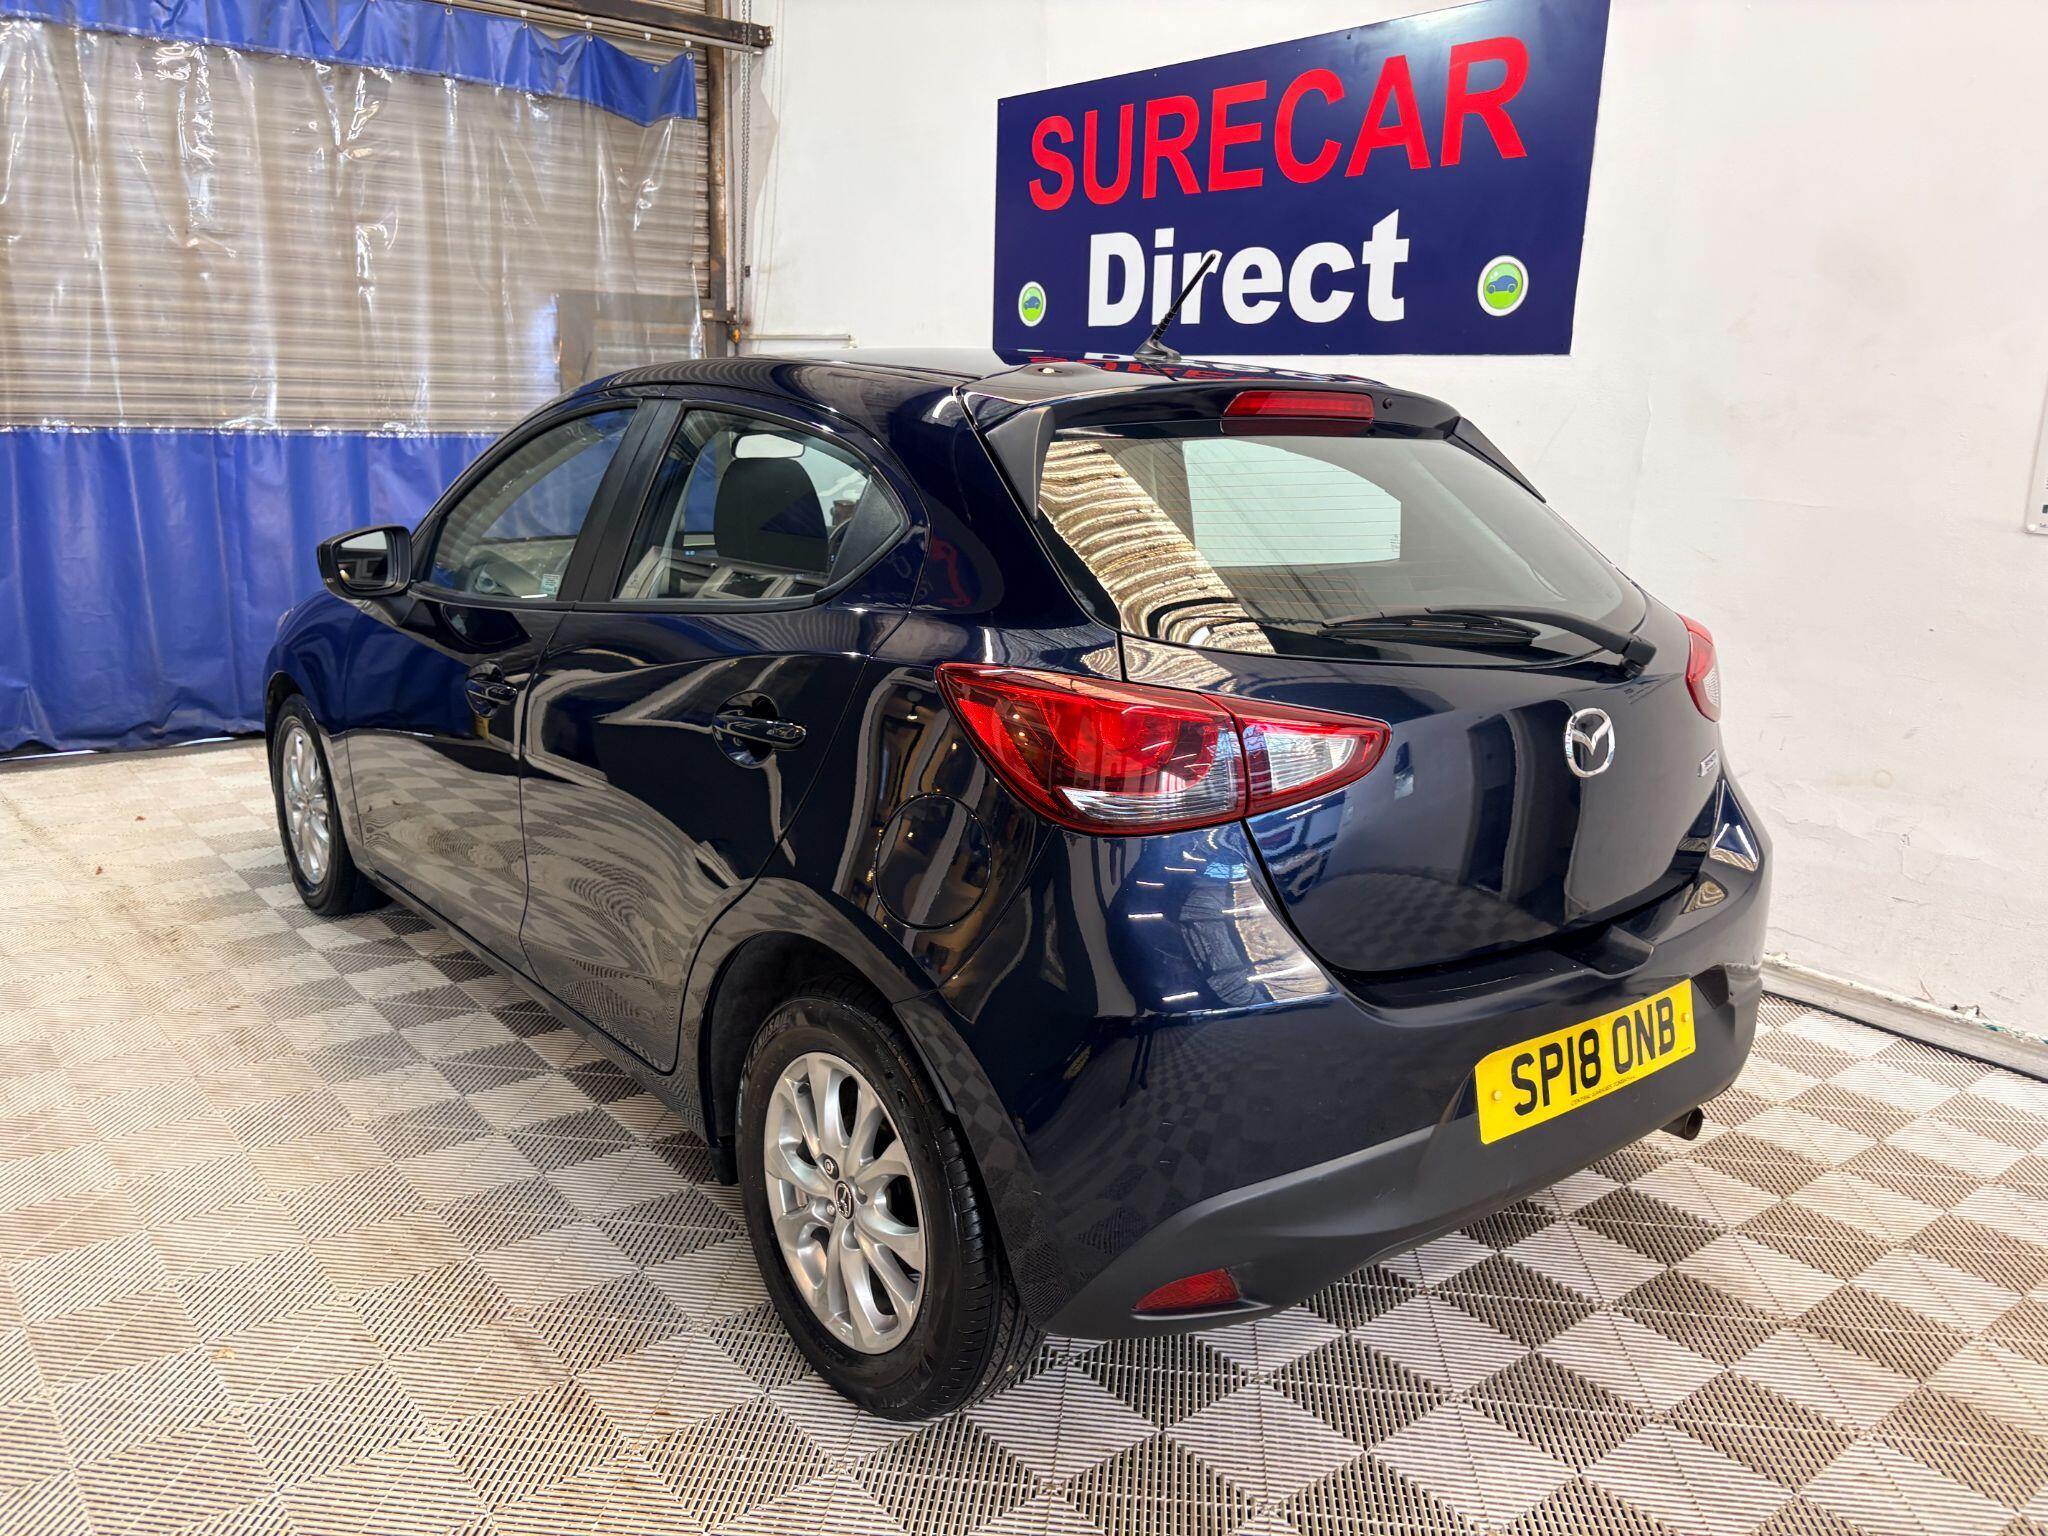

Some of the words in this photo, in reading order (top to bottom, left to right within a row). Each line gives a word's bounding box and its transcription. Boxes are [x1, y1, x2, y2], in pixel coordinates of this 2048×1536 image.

[1029, 36, 1528, 210] SURECAR
[1088, 209, 1409, 327] Direct
[1511, 1028, 1602, 1116] SP18
[1612, 997, 1675, 1074] ONB
